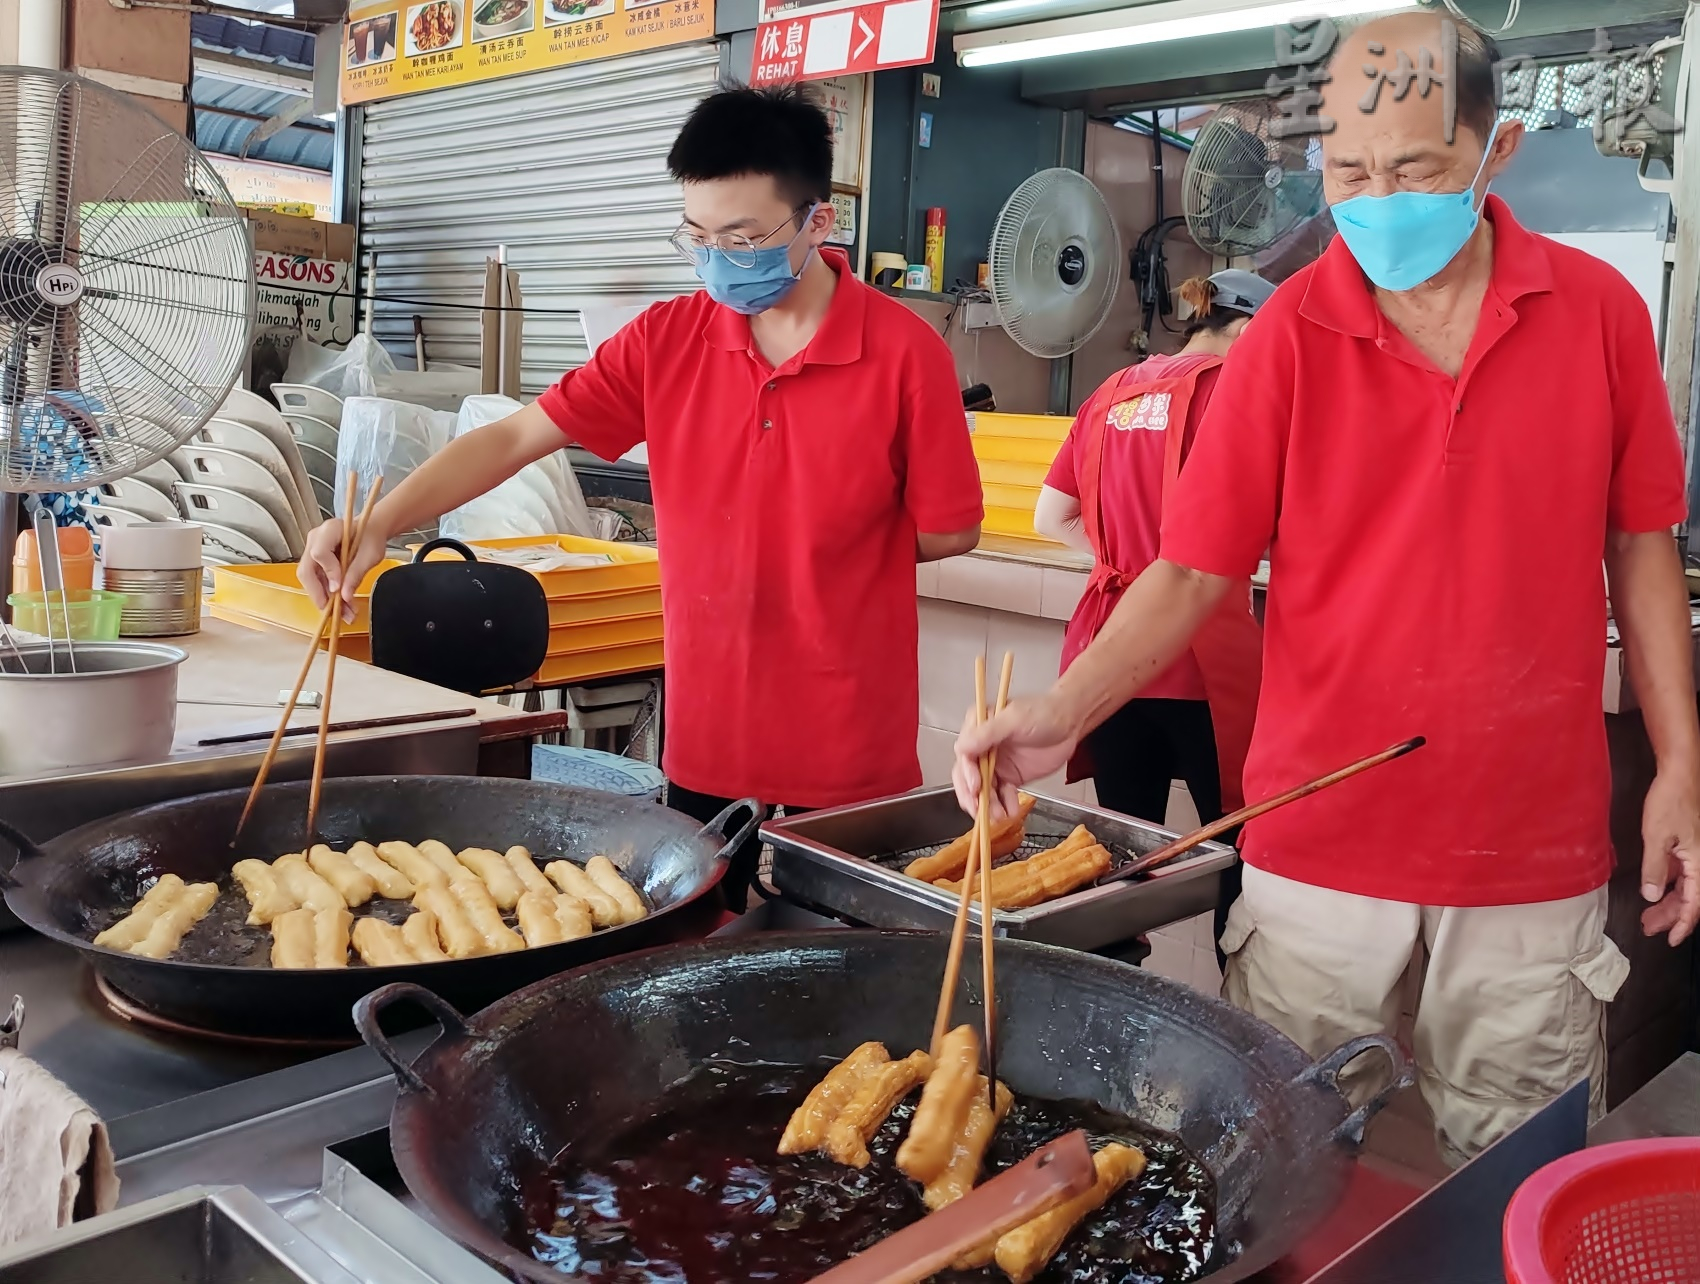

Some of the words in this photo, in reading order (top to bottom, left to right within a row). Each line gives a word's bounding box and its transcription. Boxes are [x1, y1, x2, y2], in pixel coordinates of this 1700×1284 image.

[625, 28, 636, 37] KAM
[638, 25, 647, 34] KAT
[648, 22, 664, 32] SEJUK
[670, 17, 686, 28] BARLI
[687, 13, 704, 25] SEJUK
[549, 43, 562, 52] WAN
[564, 40, 575, 49] TAN
[577, 37, 589, 47] MEE
[591, 33, 609, 44] KICAP
[761, 22, 804, 61] 休息
[478, 57, 490, 66] WAN
[491, 55, 501, 64] TAN
[503, 52, 514, 62] MEE
[516, 50, 526, 59] SUP
[415, 70, 424, 78] TAN
[425, 68, 435, 76] MEE
[437, 66, 449, 74] KARI
[449, 63, 464, 71] AYAM
[757, 60, 798, 81] REHAT
[365, 80, 373, 88] TEH
[374, 77, 388, 86] SEJUK
[255, 254, 335, 284] EASONS
[50, 279, 74, 292] HPi
[258, 311, 288, 326] lihan
[292, 317, 321, 332] yng
